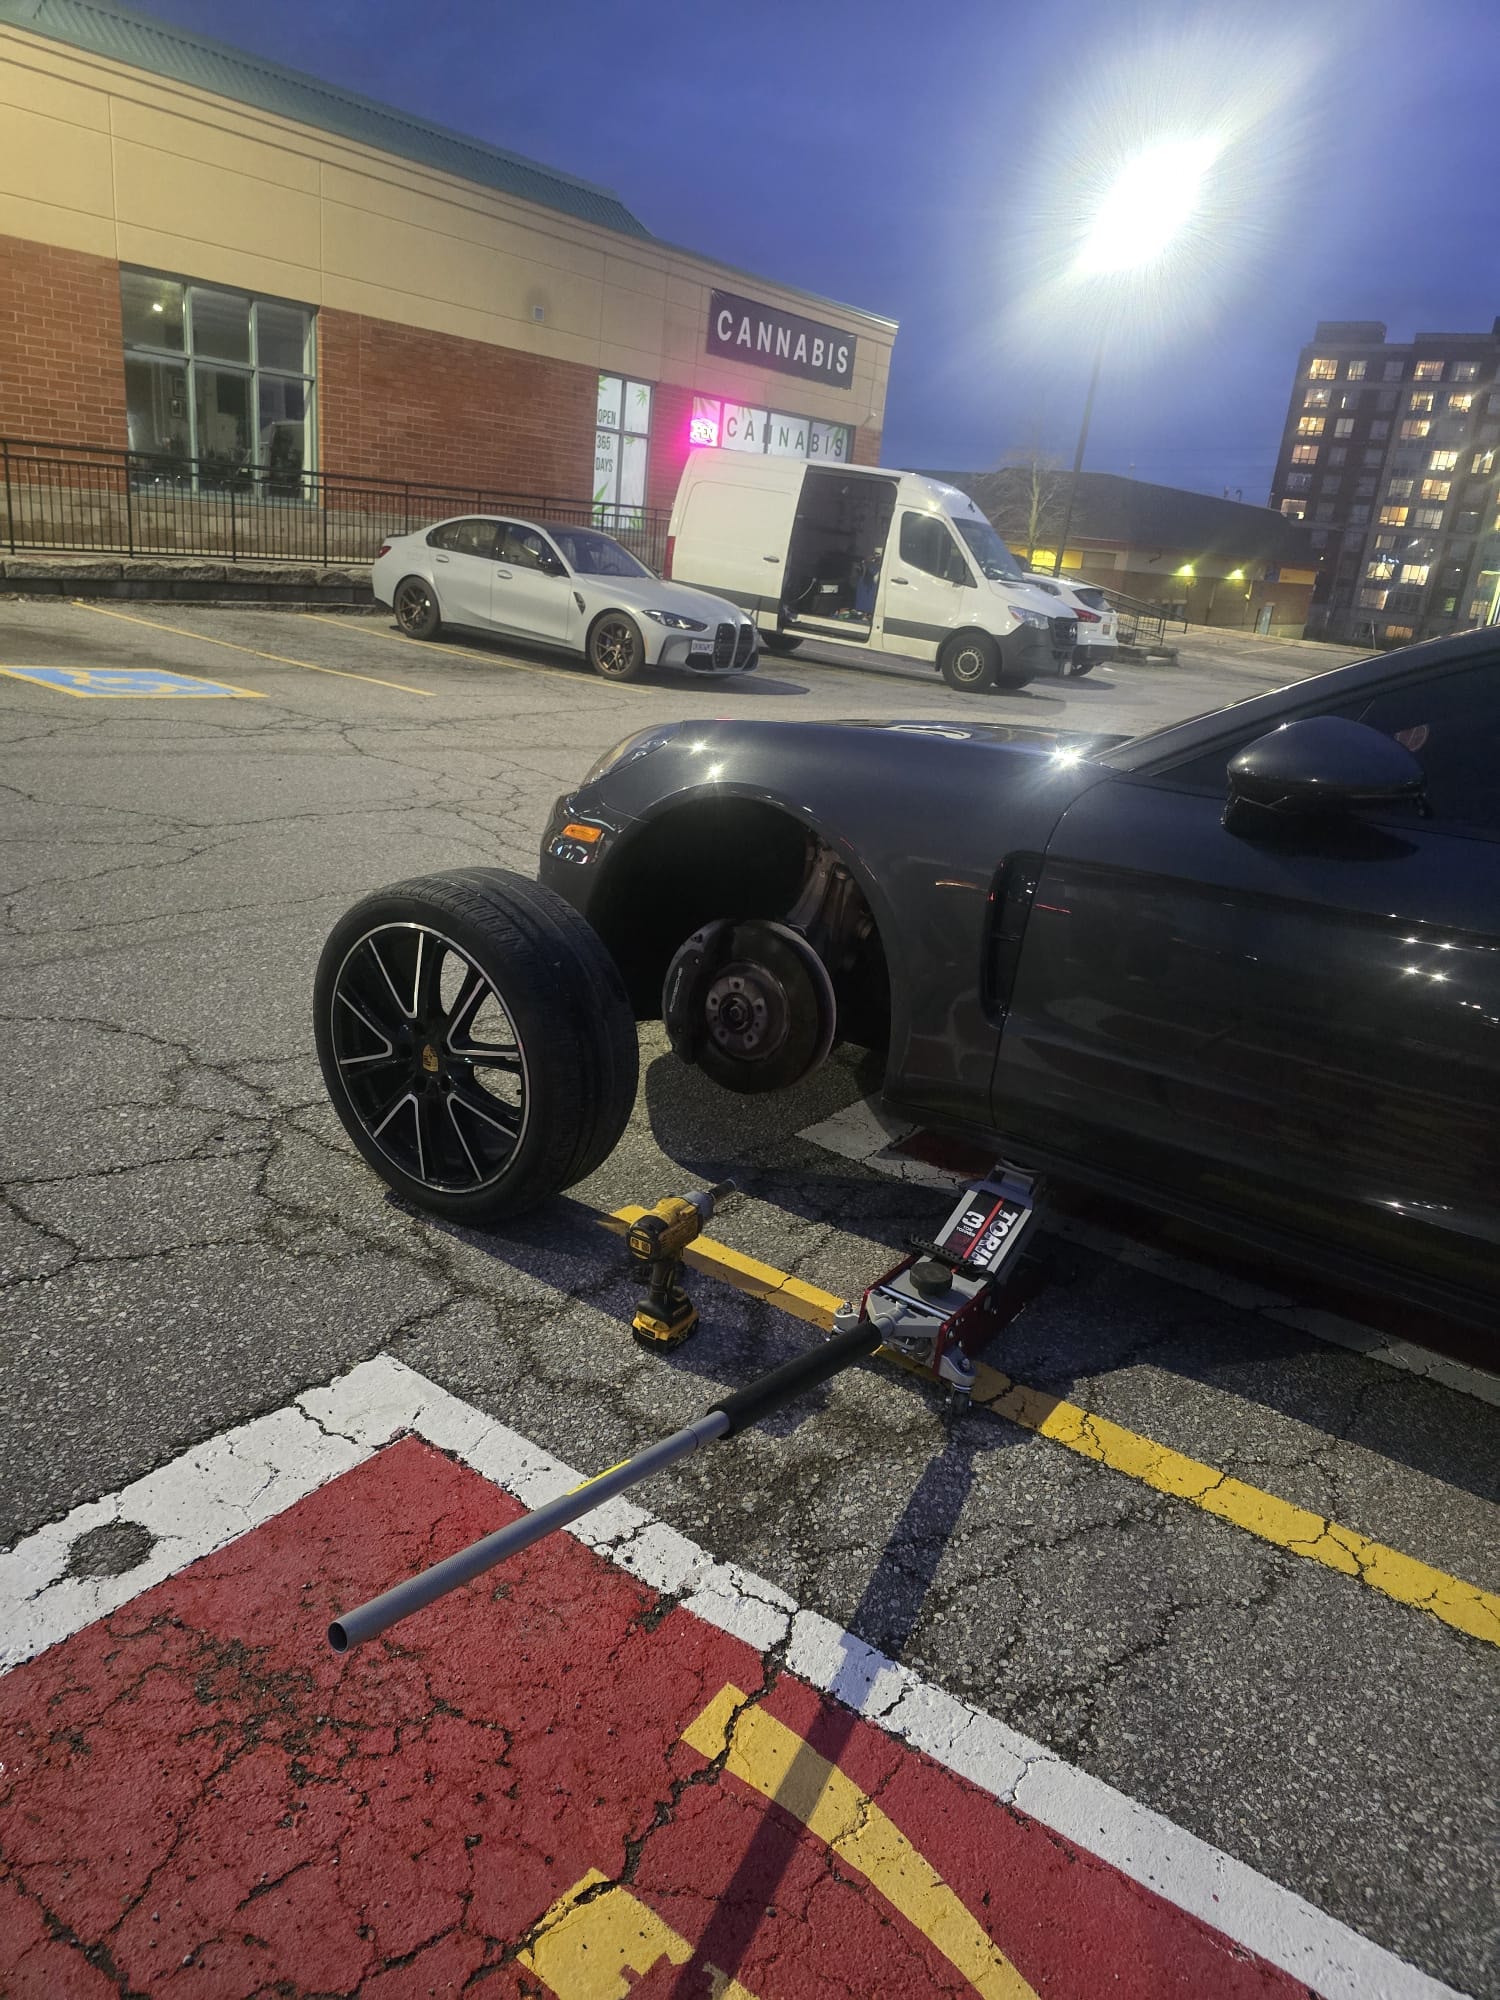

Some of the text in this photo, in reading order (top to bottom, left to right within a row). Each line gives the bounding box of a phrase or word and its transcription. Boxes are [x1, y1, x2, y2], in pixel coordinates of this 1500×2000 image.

[717, 310, 848, 374] CANNABIS
[598, 409, 617, 425] OPEN
[597, 434, 611, 450] 365
[595, 457, 613, 473] DAYS
[962, 1210, 986, 1229] 3
